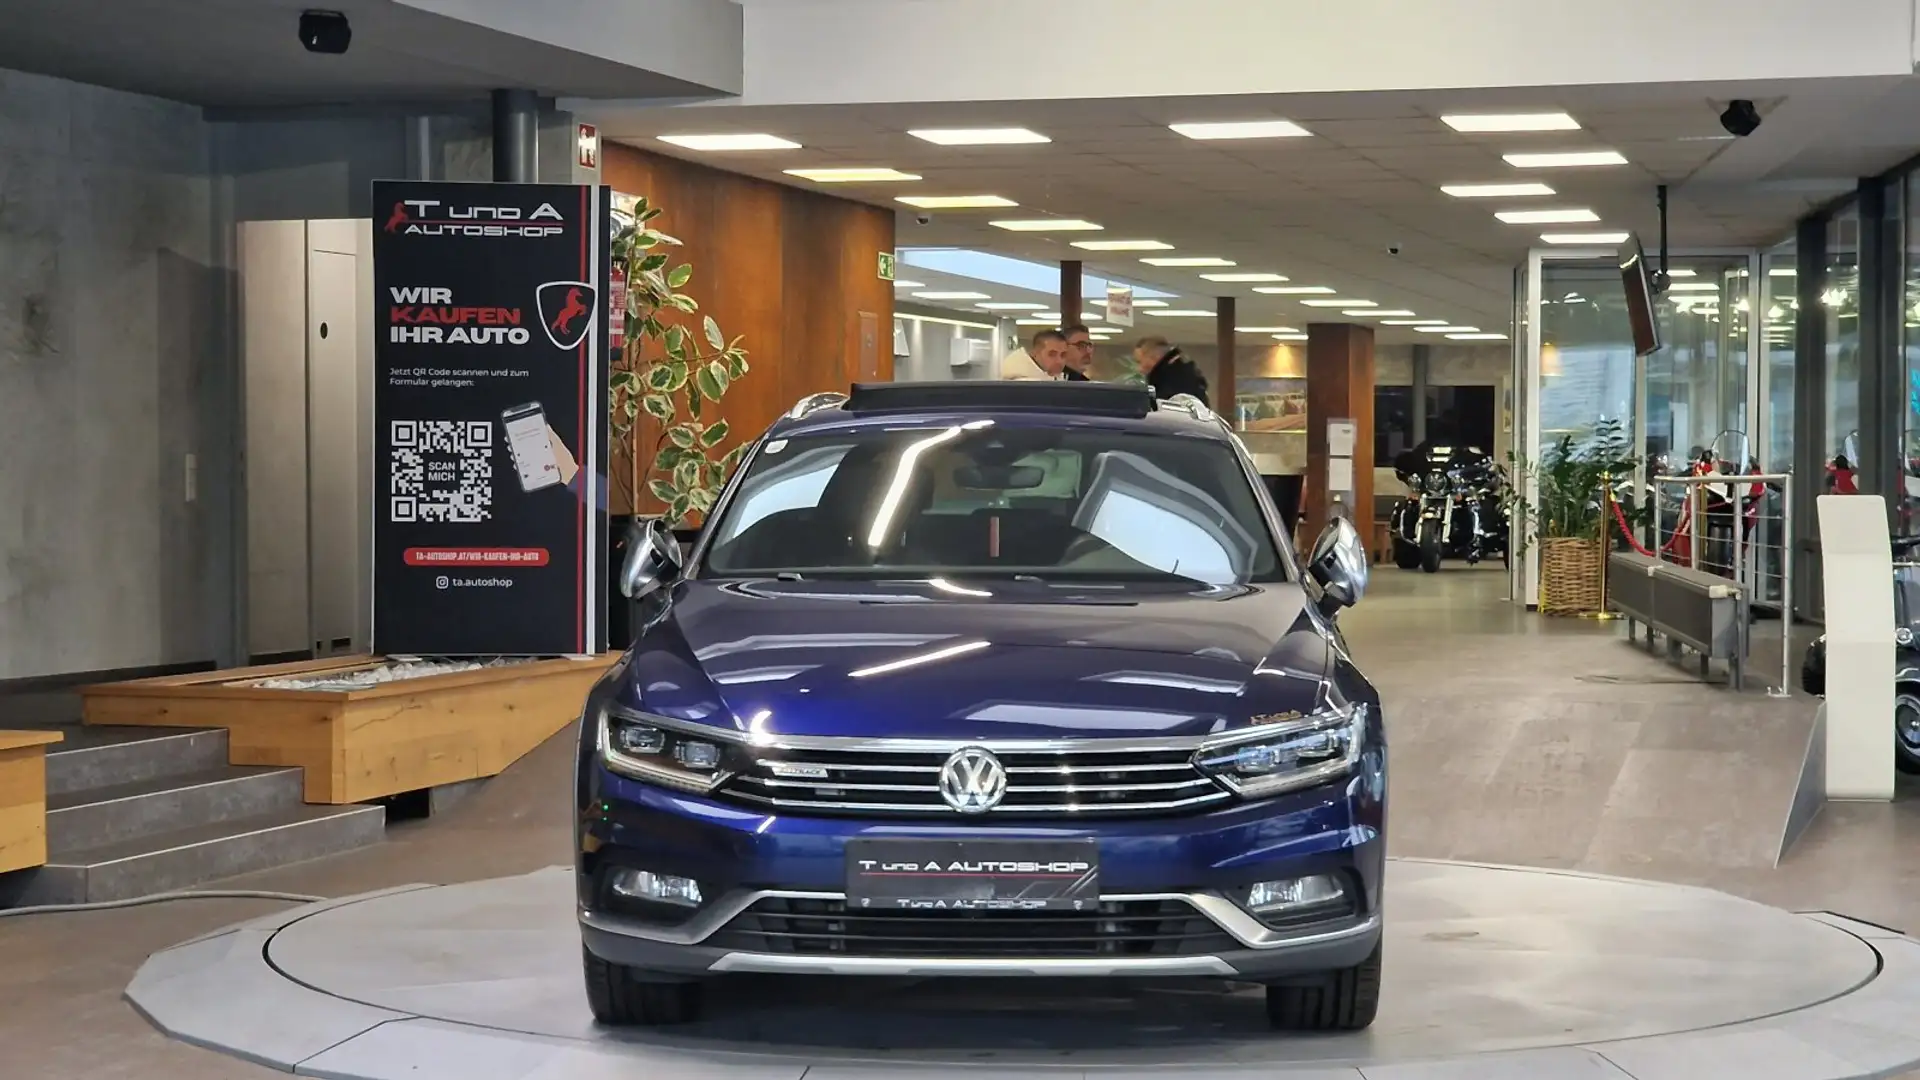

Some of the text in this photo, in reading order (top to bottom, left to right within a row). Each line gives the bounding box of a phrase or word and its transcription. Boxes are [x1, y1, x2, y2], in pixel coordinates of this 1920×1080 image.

[404, 200, 441, 217] T
[529, 203, 564, 221] A
[404, 224, 564, 237] AUTOSHOP
[389, 286, 452, 304] WIR
[390, 307, 521, 324] KAUFEN
[390, 326, 530, 345] IHR AUTO
[389, 368, 411, 376] Jetzt
[412, 368, 426, 377] QR
[428, 368, 451, 376] Code
[452, 369, 489, 377] scannen
[490, 369, 508, 377] und
[389, 378, 475, 388] Formular gelangen:
[428, 461, 456, 471] SCAN
[428, 472, 456, 481] MICH
[452, 577, 513, 588] ta.autoshop
[858, 860, 877, 870] T
[923, 861, 941, 871] A
[947, 861, 1089, 873] AUTOSHOP
[897, 899, 910, 908] T
[935, 899, 947, 908] A
[952, 899, 1047, 909] AUTOSHOP
